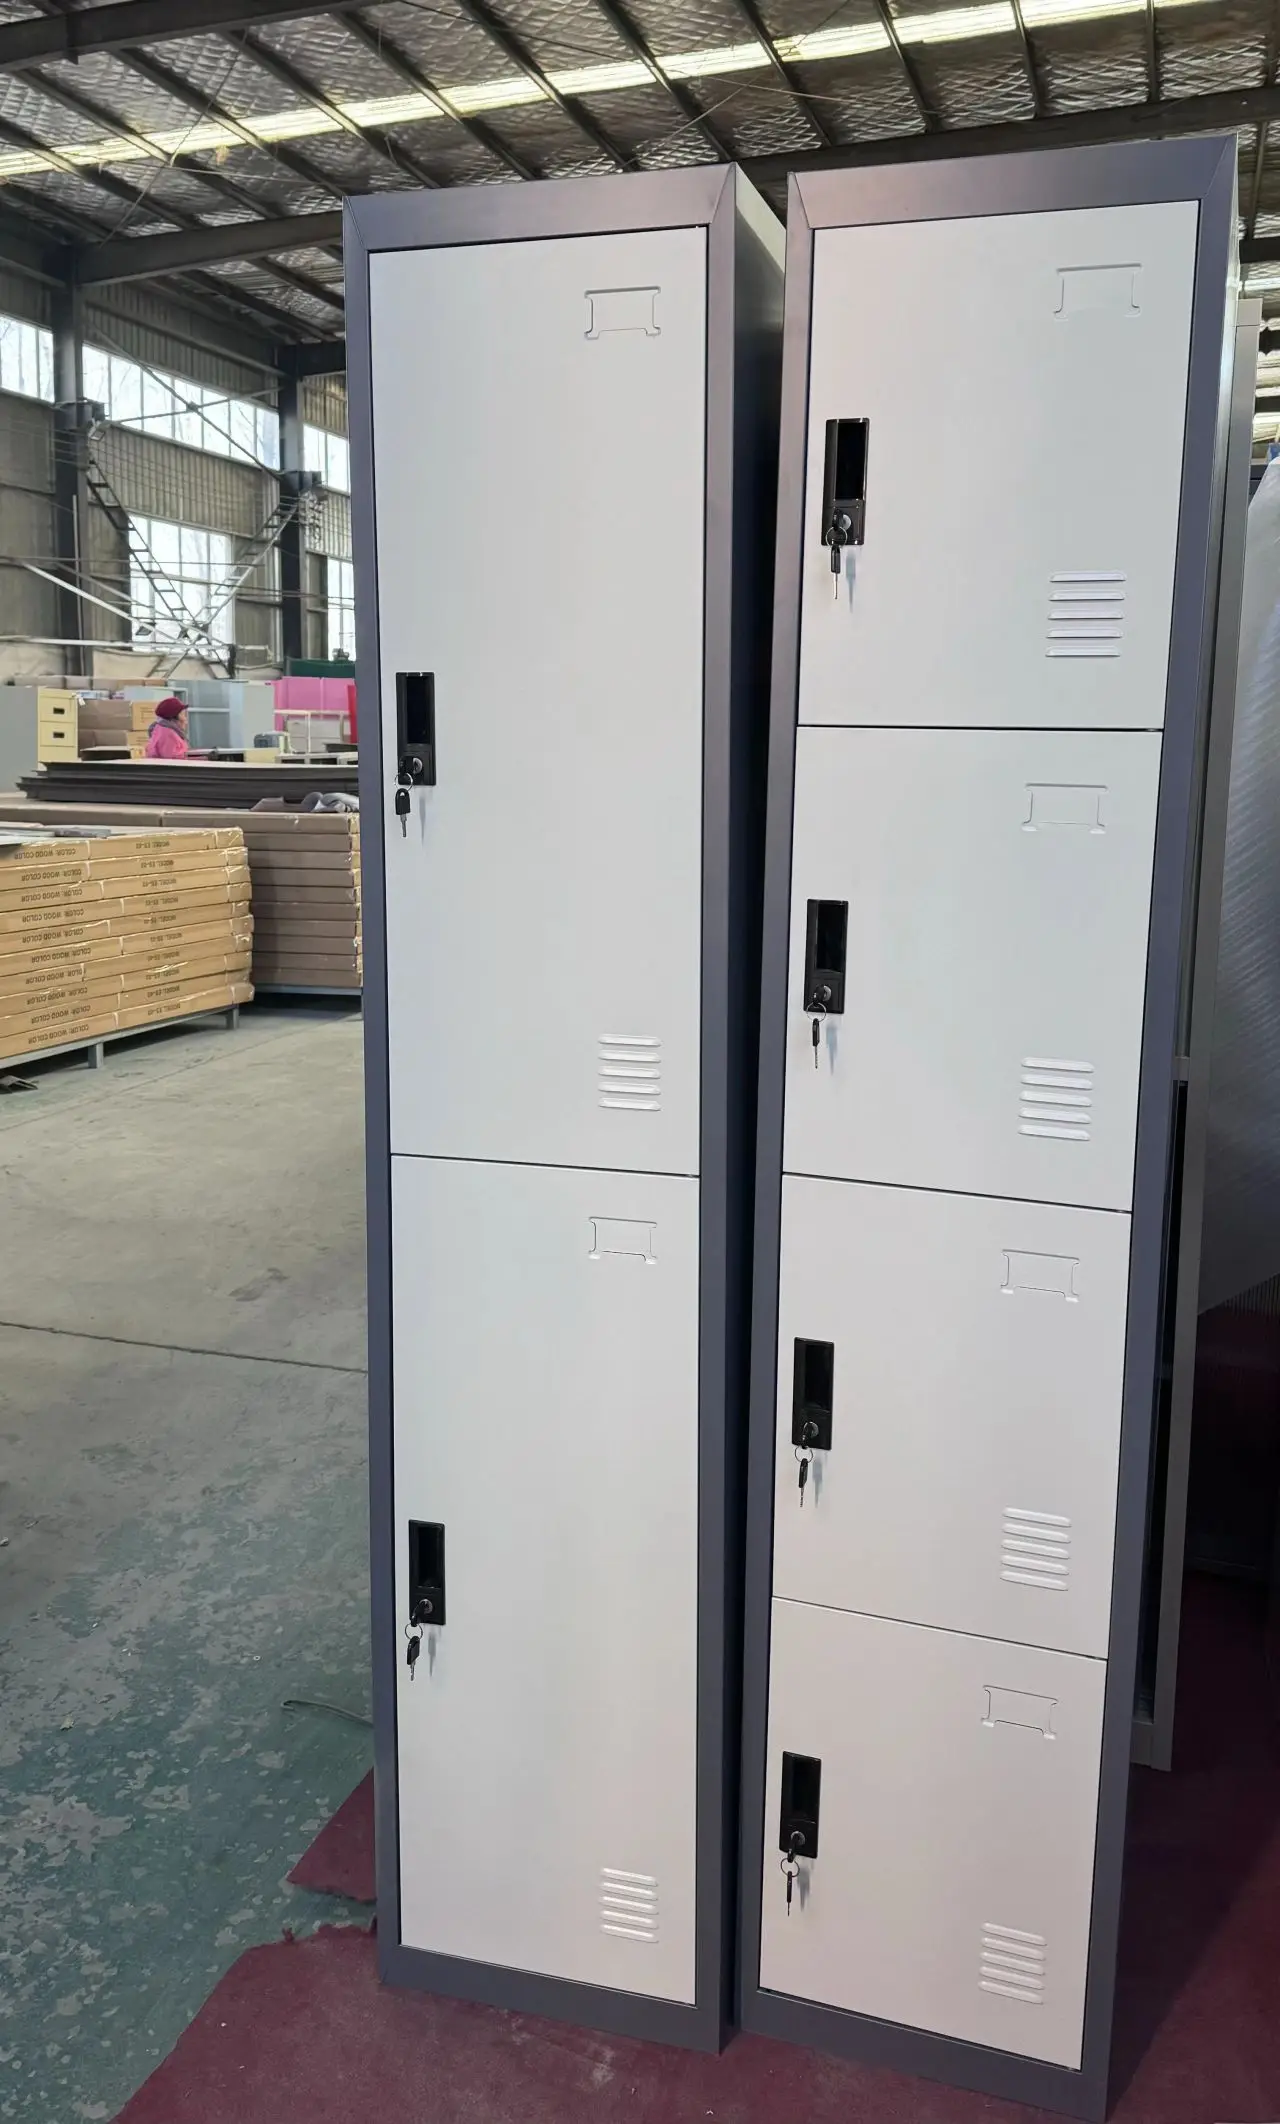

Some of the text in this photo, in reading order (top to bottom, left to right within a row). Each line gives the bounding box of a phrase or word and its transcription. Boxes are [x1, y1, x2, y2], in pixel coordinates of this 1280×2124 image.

[36, 850, 53, 858] WOOD
[43, 871, 60, 879] WOOD
[43, 891, 60, 899] WOOD
[44, 932, 61, 940] WOOD
[52, 952, 69, 960] WOOD
[47, 972, 64, 981] WOOD
[48, 991, 65, 1000] WOOD
[51, 1010, 69, 1019] WOOD
[49, 1030, 67, 1039] WOOD
